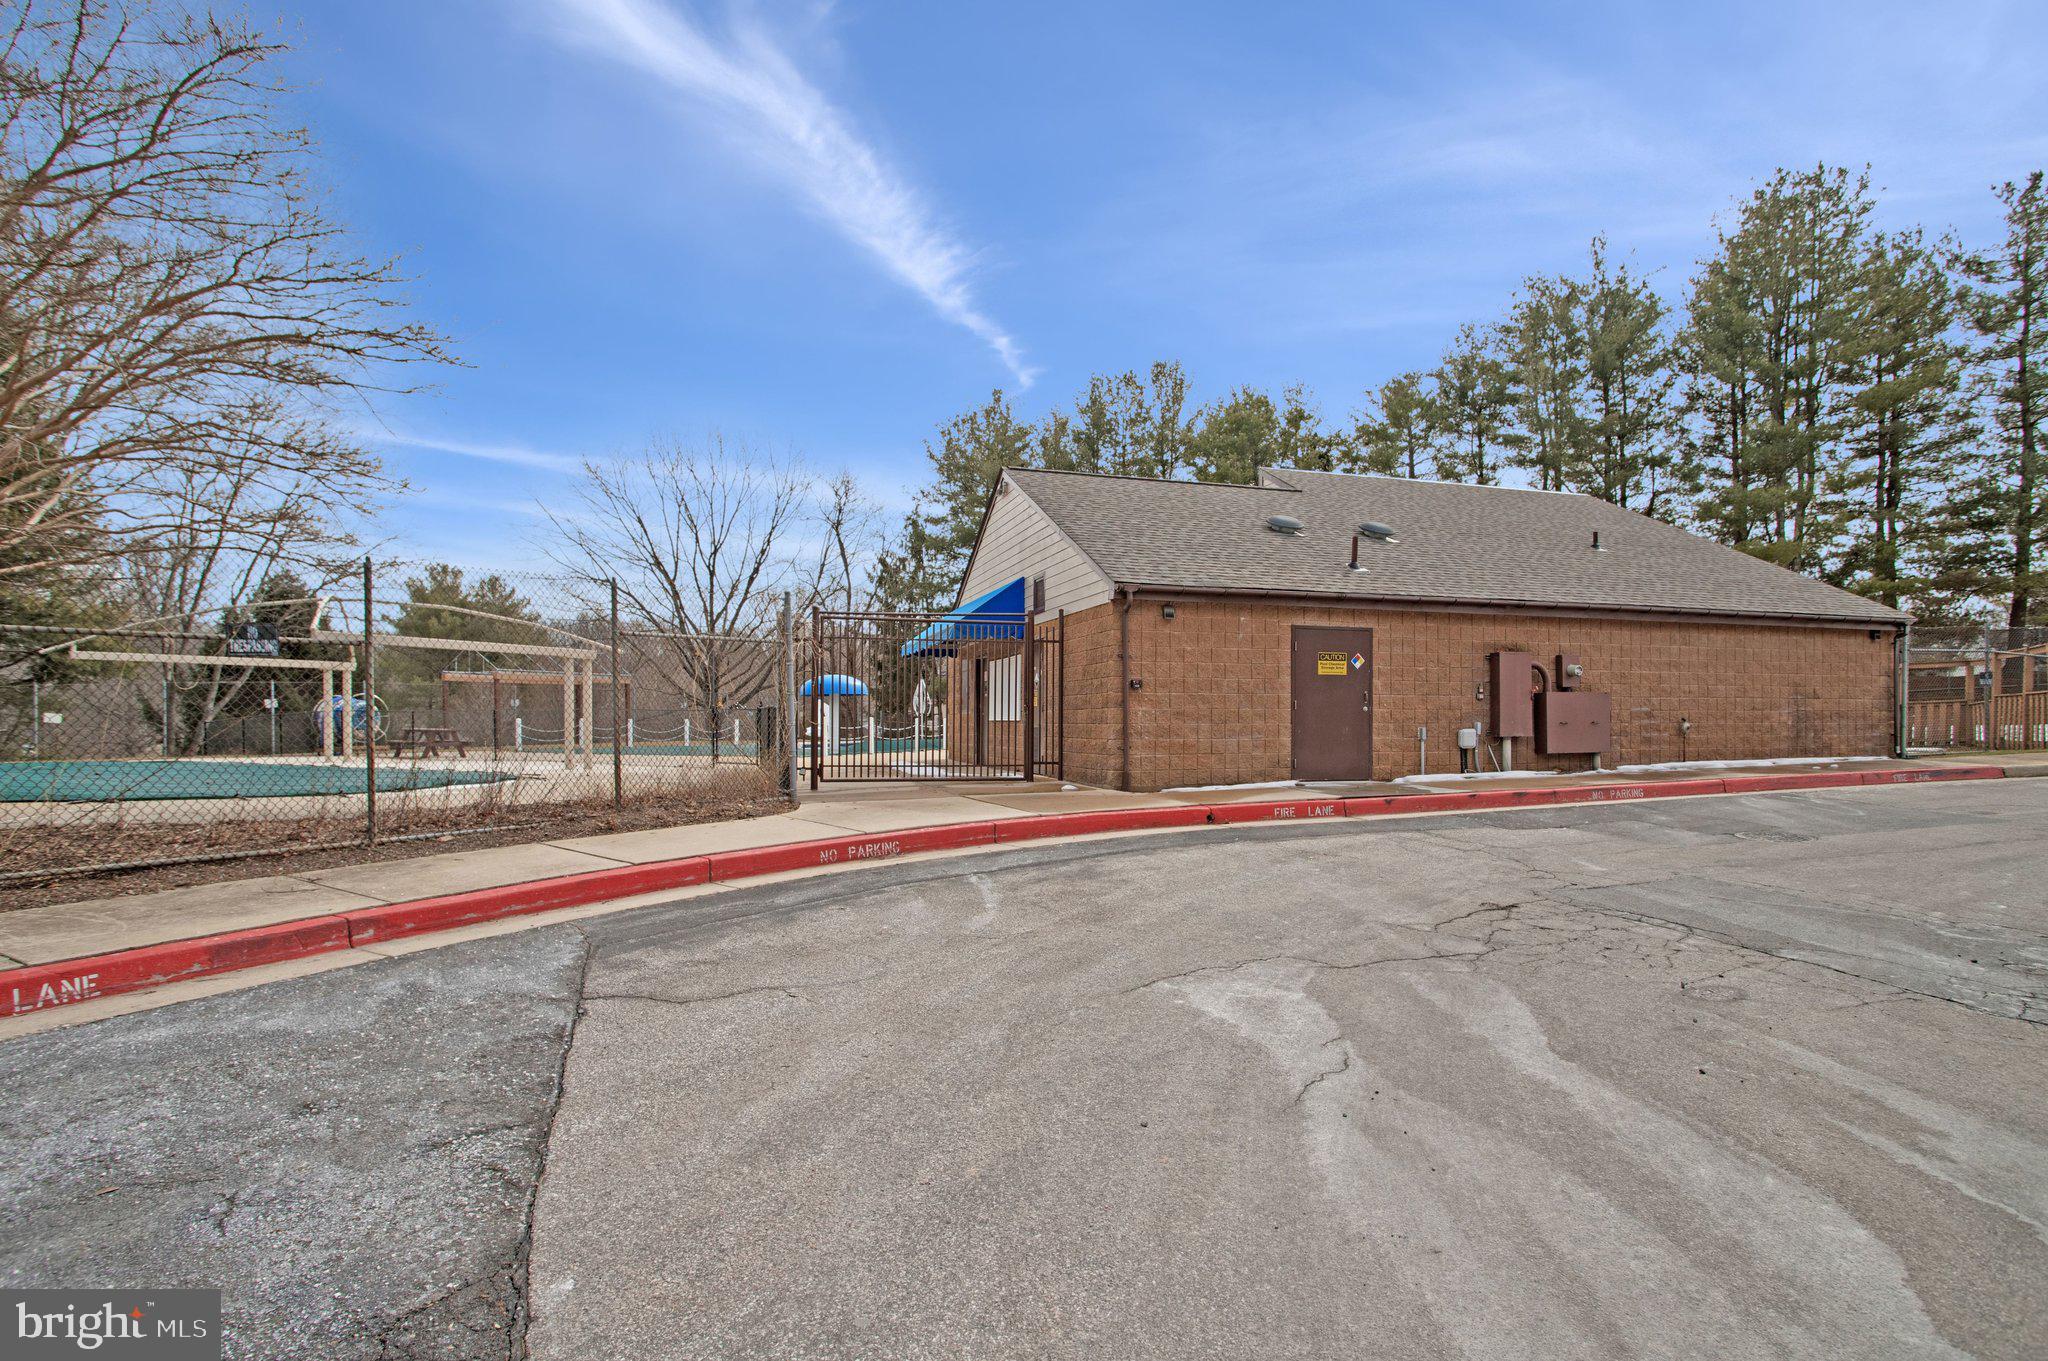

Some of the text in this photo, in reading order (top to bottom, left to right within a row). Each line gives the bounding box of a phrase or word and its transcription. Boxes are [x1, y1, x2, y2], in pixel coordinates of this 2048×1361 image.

[1320, 653, 1346, 661] CAUTION
[1592, 787, 1644, 800] NO PARKING
[1274, 805, 1335, 818] FIRE LANE
[820, 841, 900, 864] NO PARKING
[12, 973, 101, 1012] LANE
